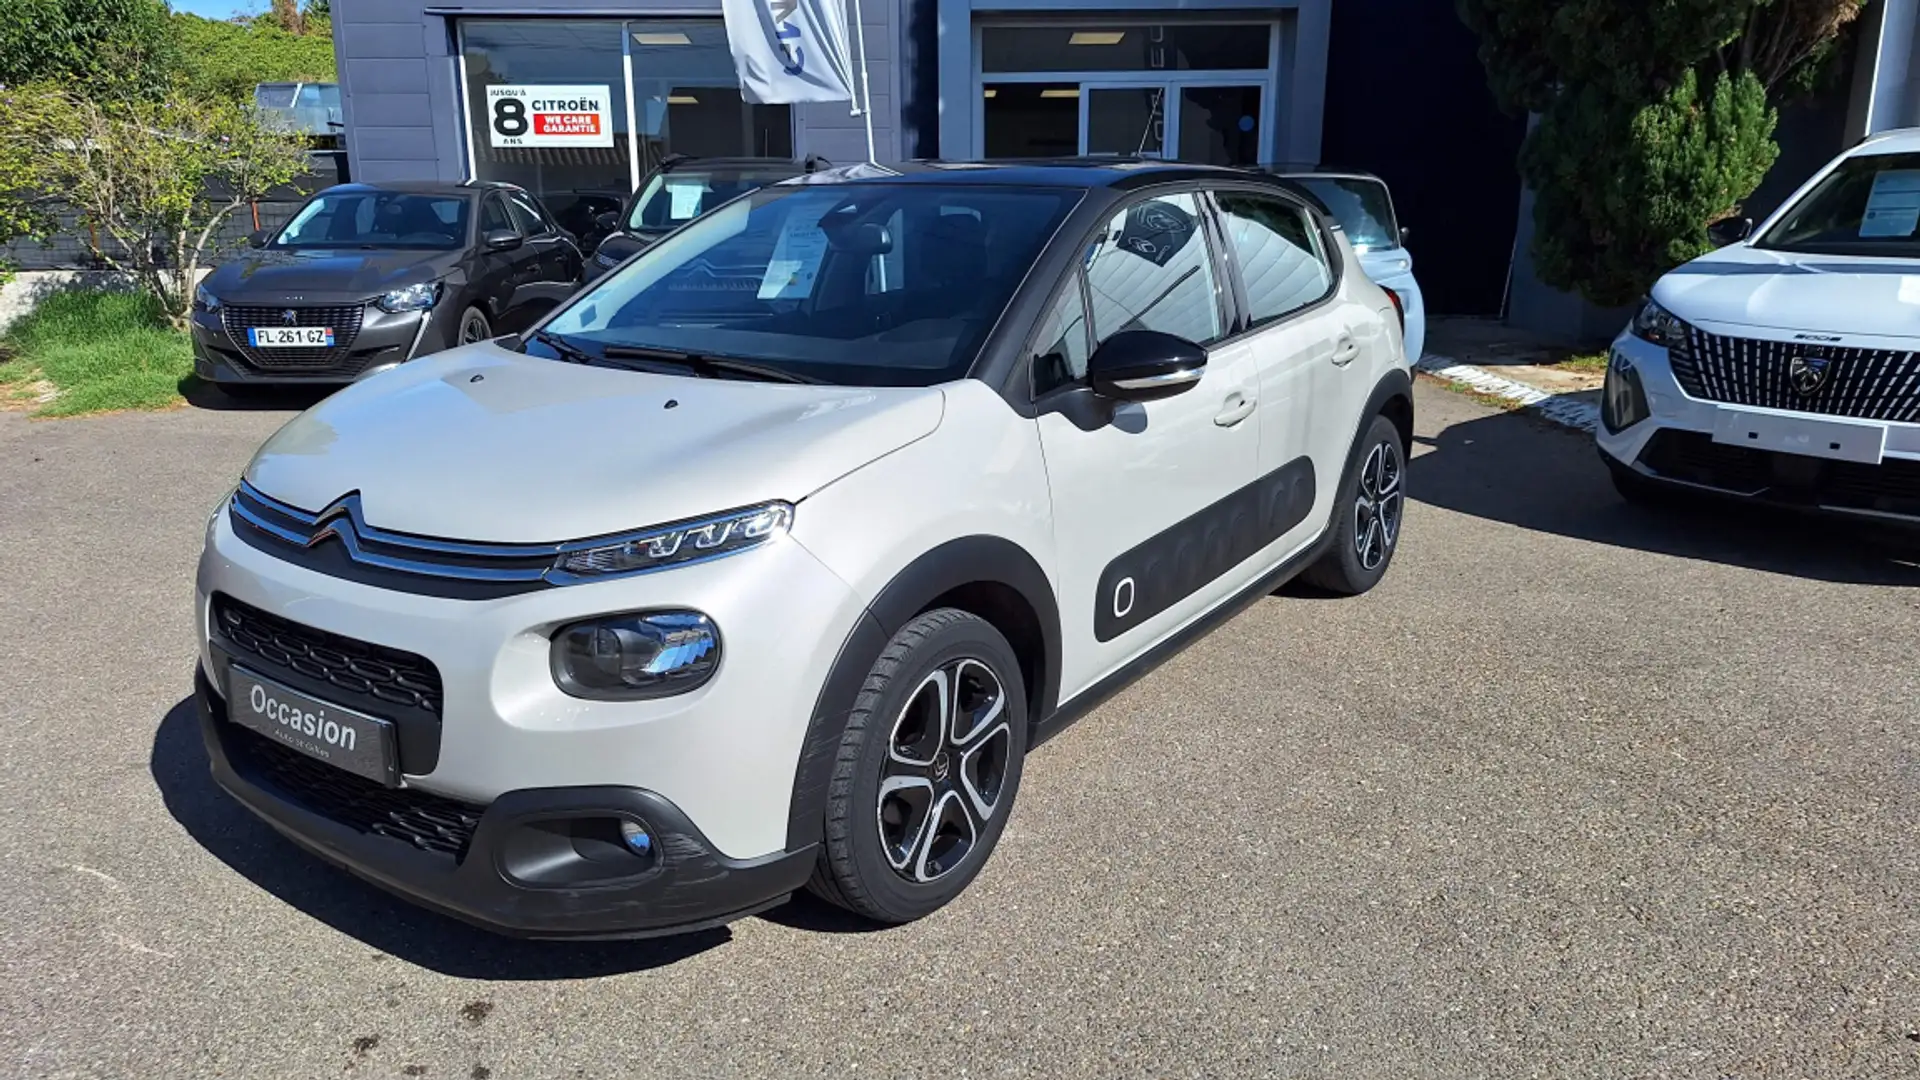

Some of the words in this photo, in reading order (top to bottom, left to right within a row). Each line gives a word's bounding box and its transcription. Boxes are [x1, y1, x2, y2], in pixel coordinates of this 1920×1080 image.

[531, 97, 600, 111] CITROËN
[493, 97, 529, 136] 8
[544, 115, 561, 124] WE
[563, 115, 592, 124] CARE
[543, 124, 596, 133] GARANTIE
[251, 684, 356, 751] Occasion
